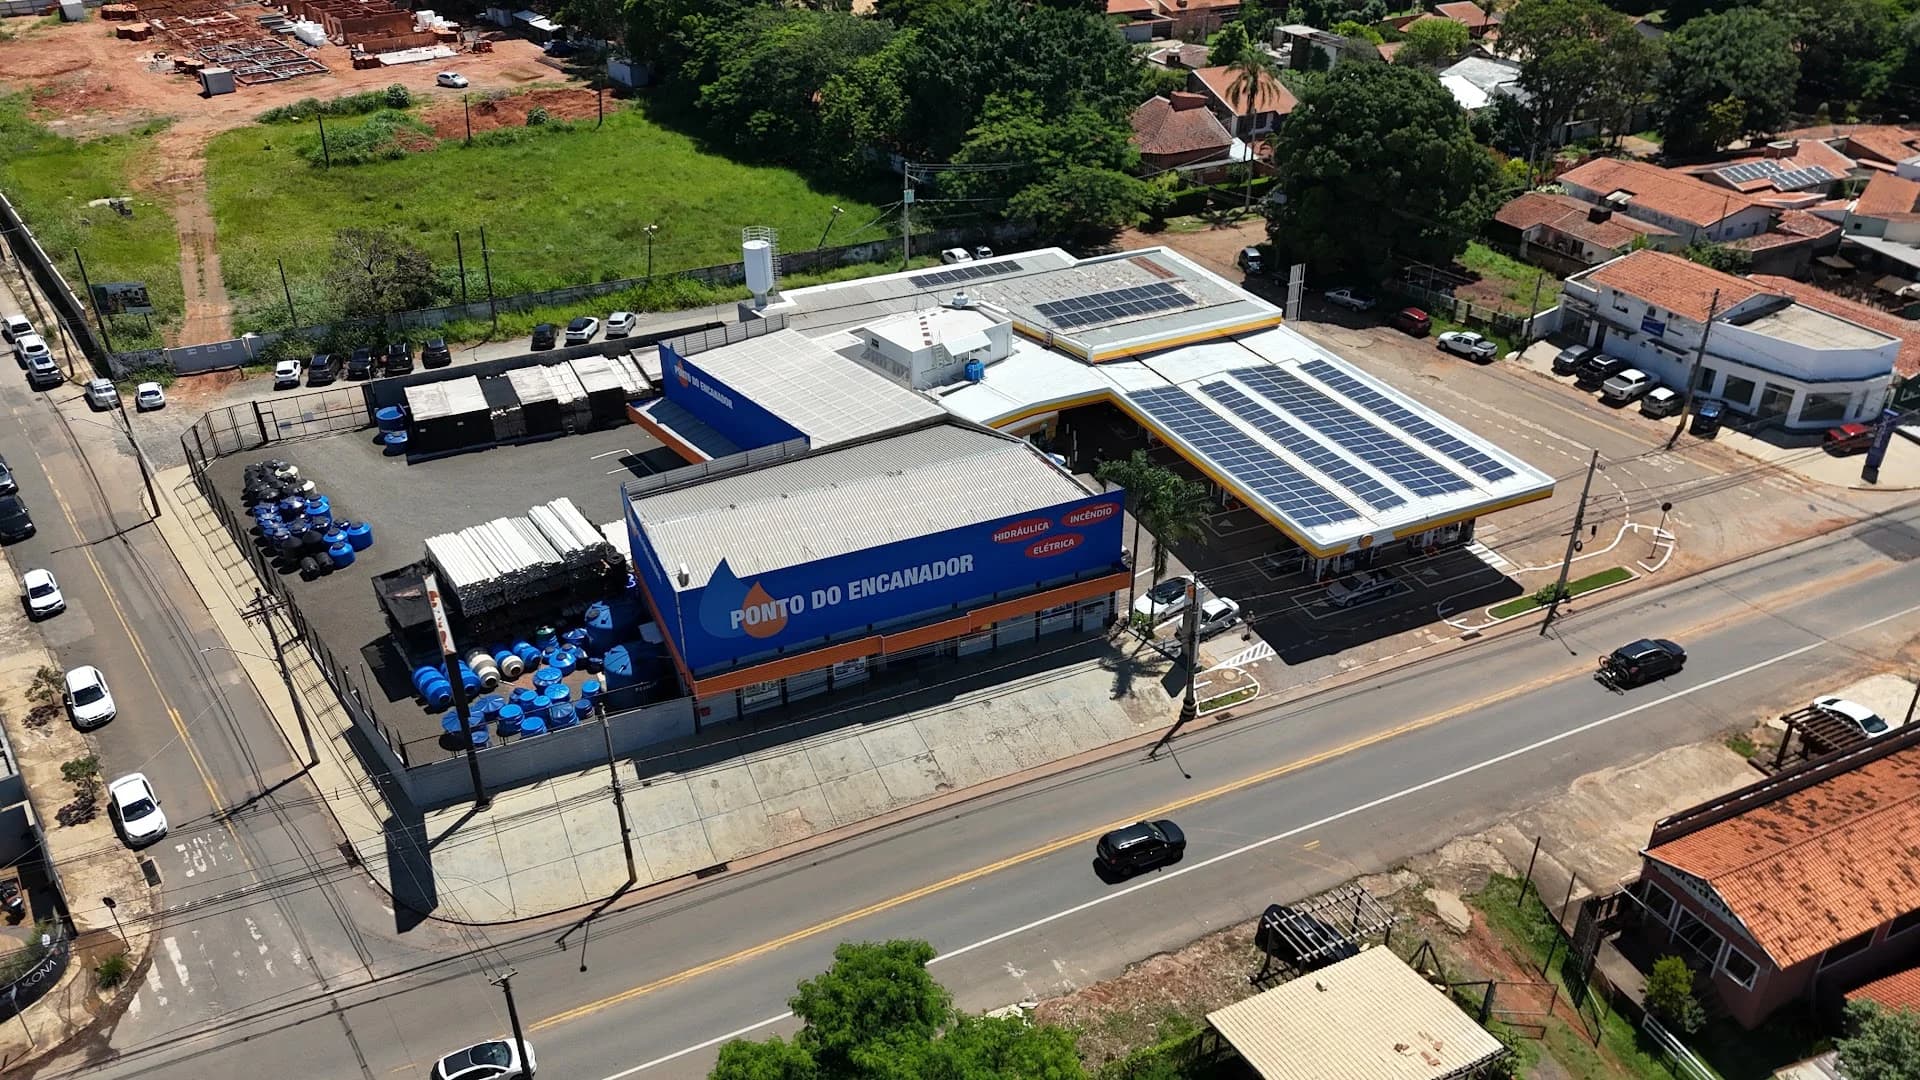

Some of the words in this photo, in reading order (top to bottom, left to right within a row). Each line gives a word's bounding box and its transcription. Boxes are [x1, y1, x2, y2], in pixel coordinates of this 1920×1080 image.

[1070, 507, 1112, 524] INCÊNDIO
[993, 522, 1049, 542] HIDRÁULICA
[1033, 538, 1075, 555] ELÉTRICA
[730, 594, 805, 630] PONTO
[811, 585, 842, 610] DO
[848, 553, 974, 601] ENCANADOR
